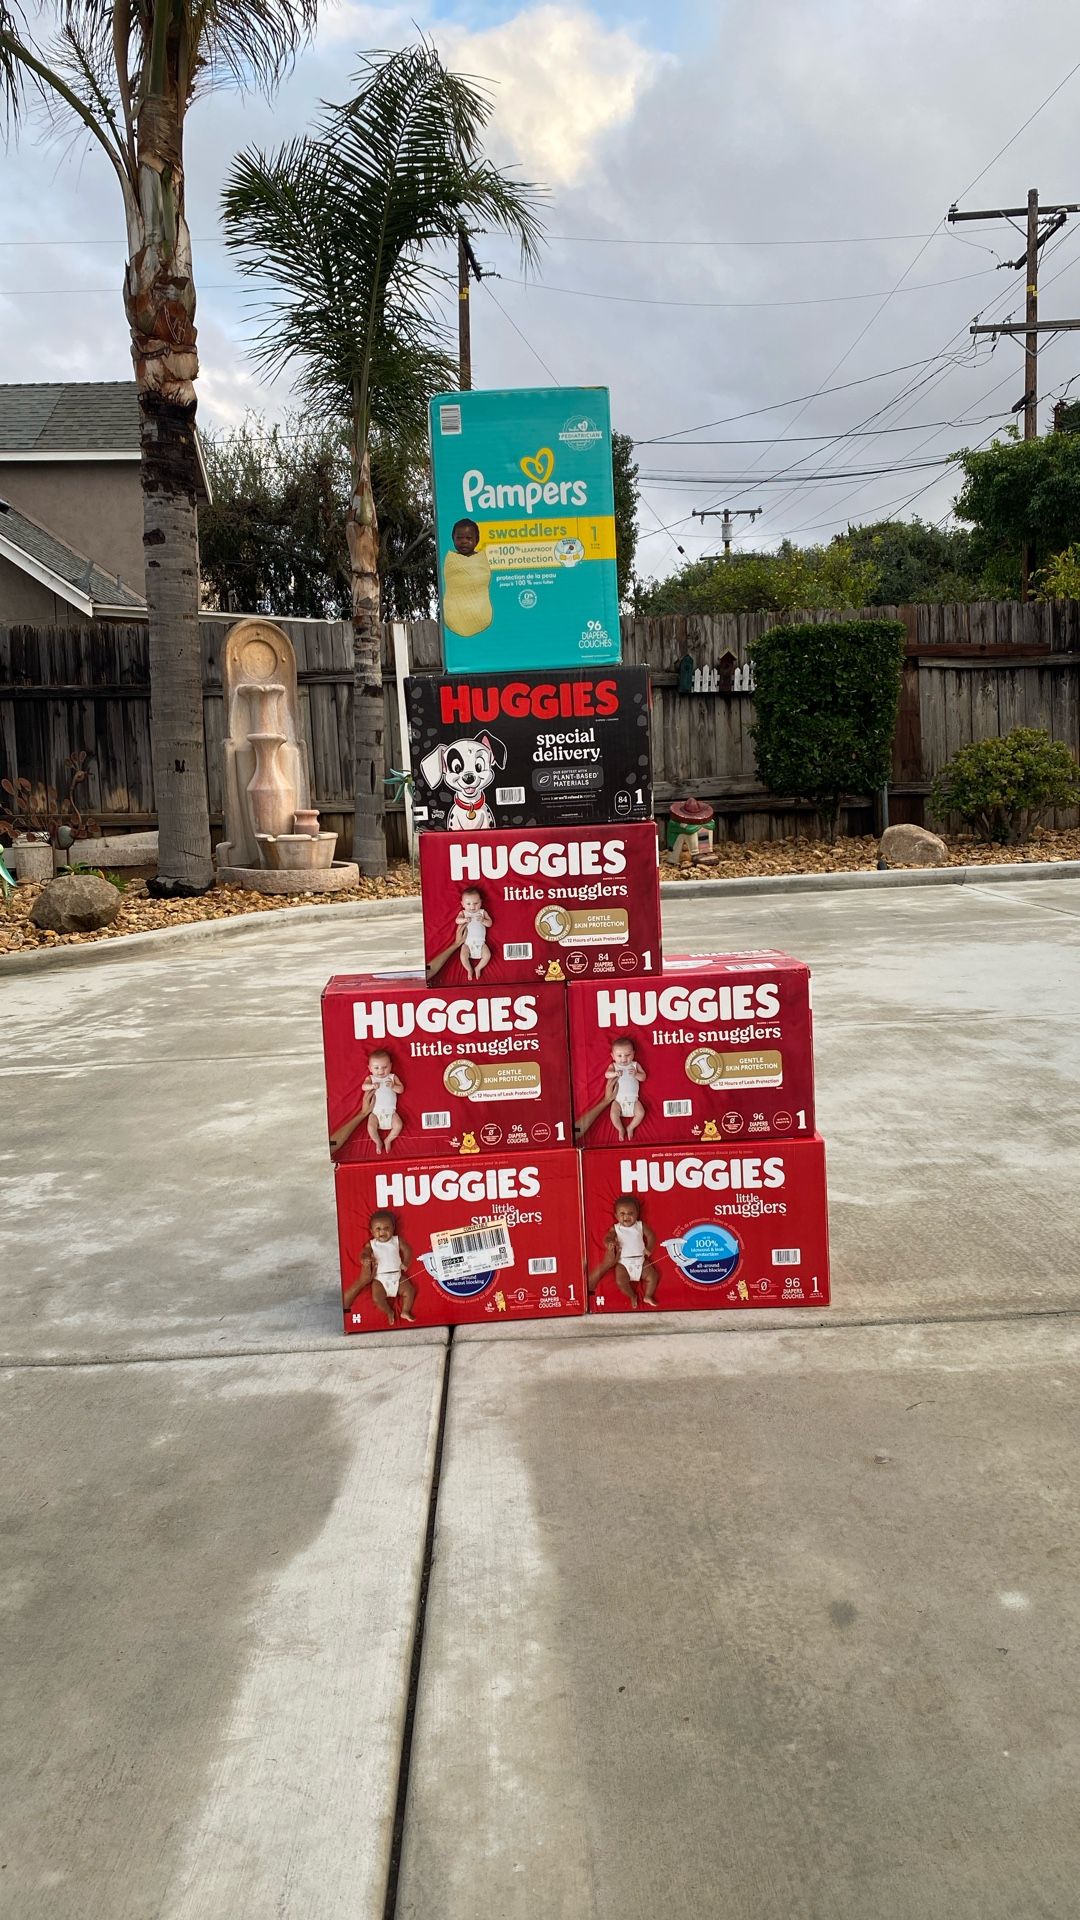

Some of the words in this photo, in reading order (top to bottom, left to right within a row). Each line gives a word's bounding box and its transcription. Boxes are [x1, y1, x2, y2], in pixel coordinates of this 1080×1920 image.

[462, 469, 587, 514] Pampers
[488, 523, 567, 540] swaddlers
[591, 526, 598, 542] 1
[521, 546, 552, 554] LEAKPROOF
[488, 556, 506, 565] skin
[508, 555, 554, 566] protection
[587, 620, 602, 631] 96
[578, 638, 612, 648] COUCHES
[582, 631, 608, 640] DIAPERS
[439, 680, 620, 724] HUGGIES
[536, 727, 595, 747] special
[532, 746, 600, 763] delivery
[635, 788, 644, 804] 1
[449, 839, 626, 881] HUGGIES
[504, 886, 544, 901] little
[548, 882, 628, 901] snugglers
[598, 953, 608, 961] 84
[642, 950, 652, 970] 1
[597, 983, 780, 1028] HUGGIES
[353, 995, 538, 1040] HUGGIES
[652, 1030, 694, 1045] little
[698, 1025, 781, 1043] snugglers
[410, 1042, 453, 1057] little
[456, 1037, 540, 1056] snugglers
[499, 1075, 536, 1083] PROTECTION
[753, 1113, 764, 1121] 96
[796, 1110, 806, 1129] 1
[512, 1124, 523, 1132] 96
[555, 1121, 565, 1141] 1
[620, 1157, 786, 1193] HUGGIES
[376, 1166, 540, 1208] HUGGIES
[736, 1193, 759, 1203] little
[492, 1204, 515, 1214] little
[714, 1199, 786, 1218] snugglers
[696, 1240, 718, 1248] 100%
[785, 1278, 800, 1287] 96
[812, 1276, 819, 1292] 1
[542, 1286, 557, 1297] 96
[568, 1284, 576, 1300] 1
